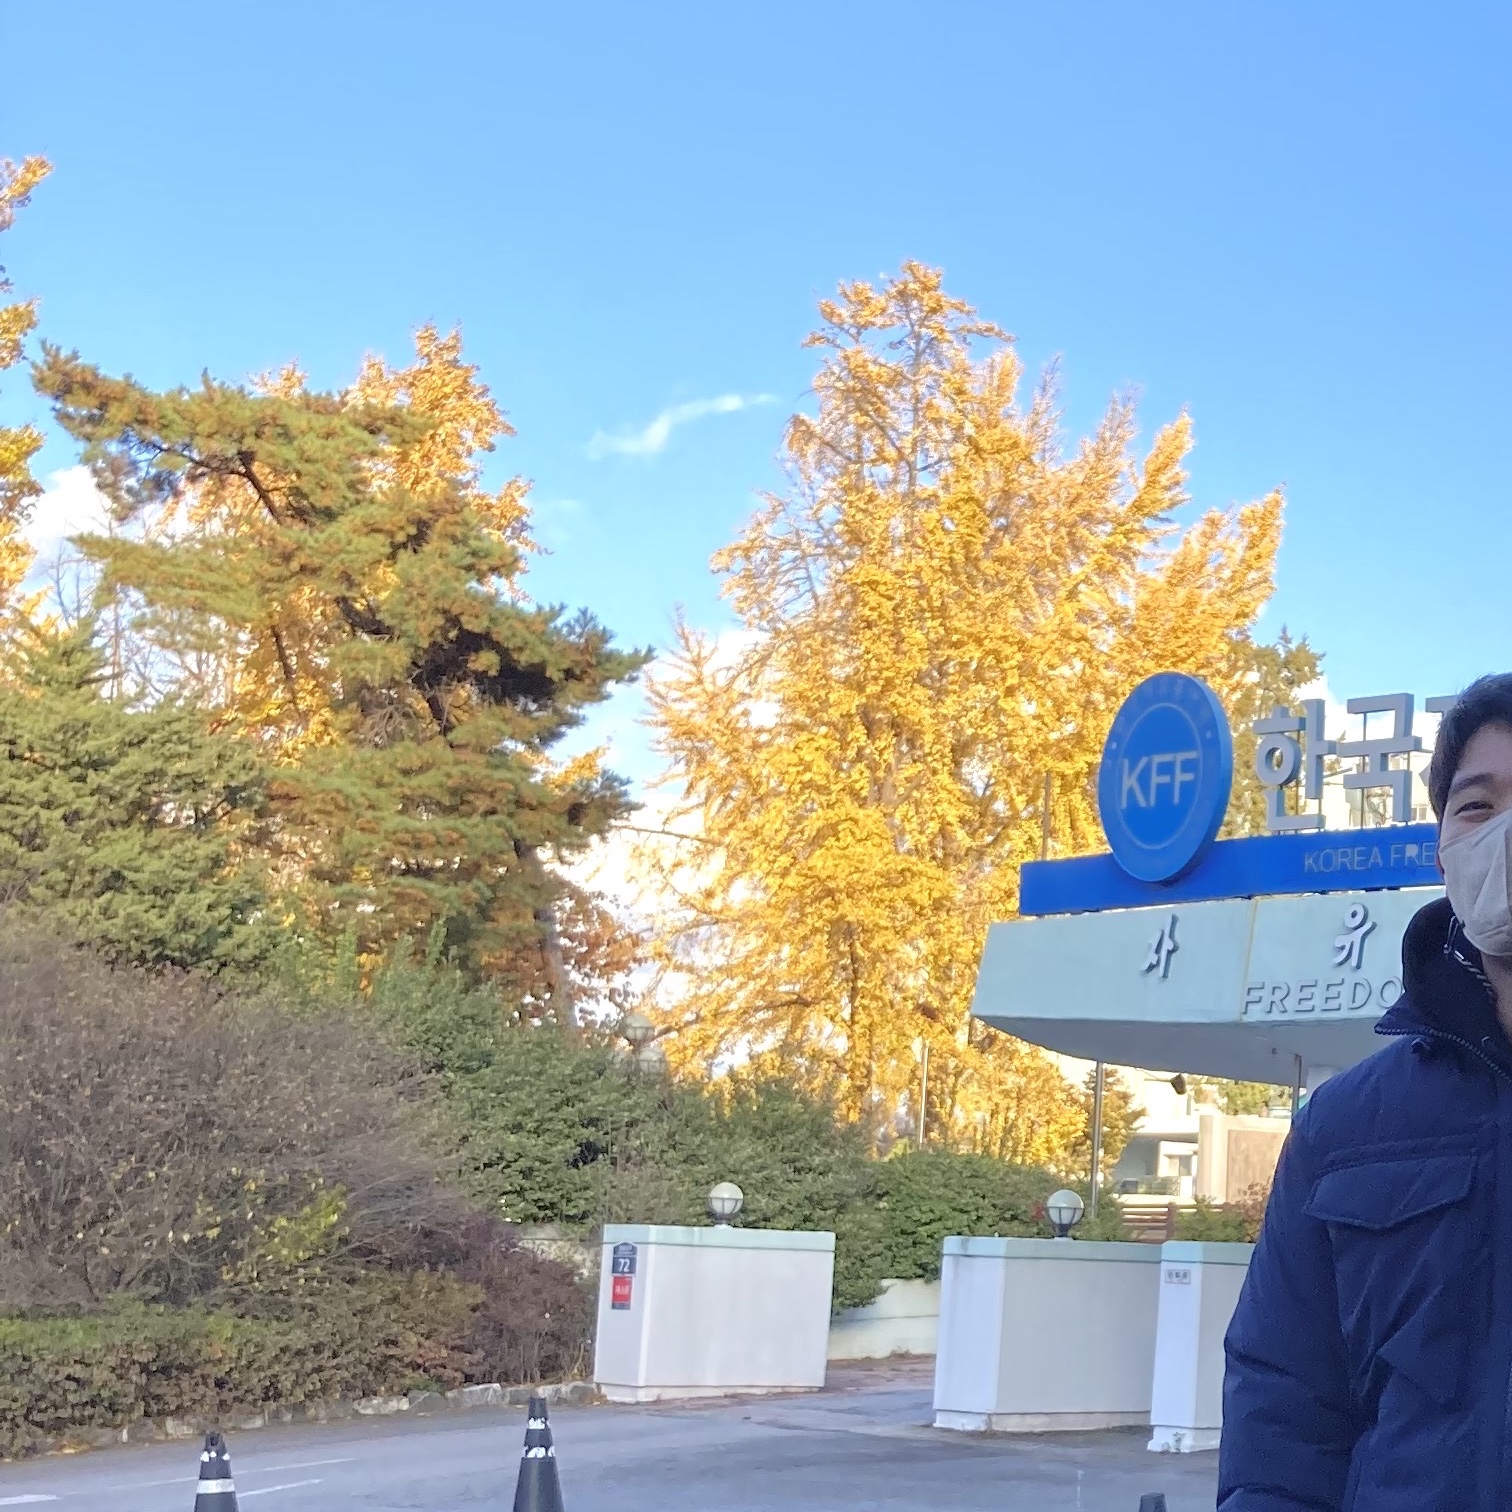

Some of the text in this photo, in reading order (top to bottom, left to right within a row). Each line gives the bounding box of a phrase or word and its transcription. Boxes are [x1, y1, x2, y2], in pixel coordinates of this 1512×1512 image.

[1120, 751, 1198, 810] KFF
[1304, 842, 1437, 873] KOREA FRE
[1241, 975, 1403, 1015] FREEDO
[617, 1258, 631, 1273] 72
